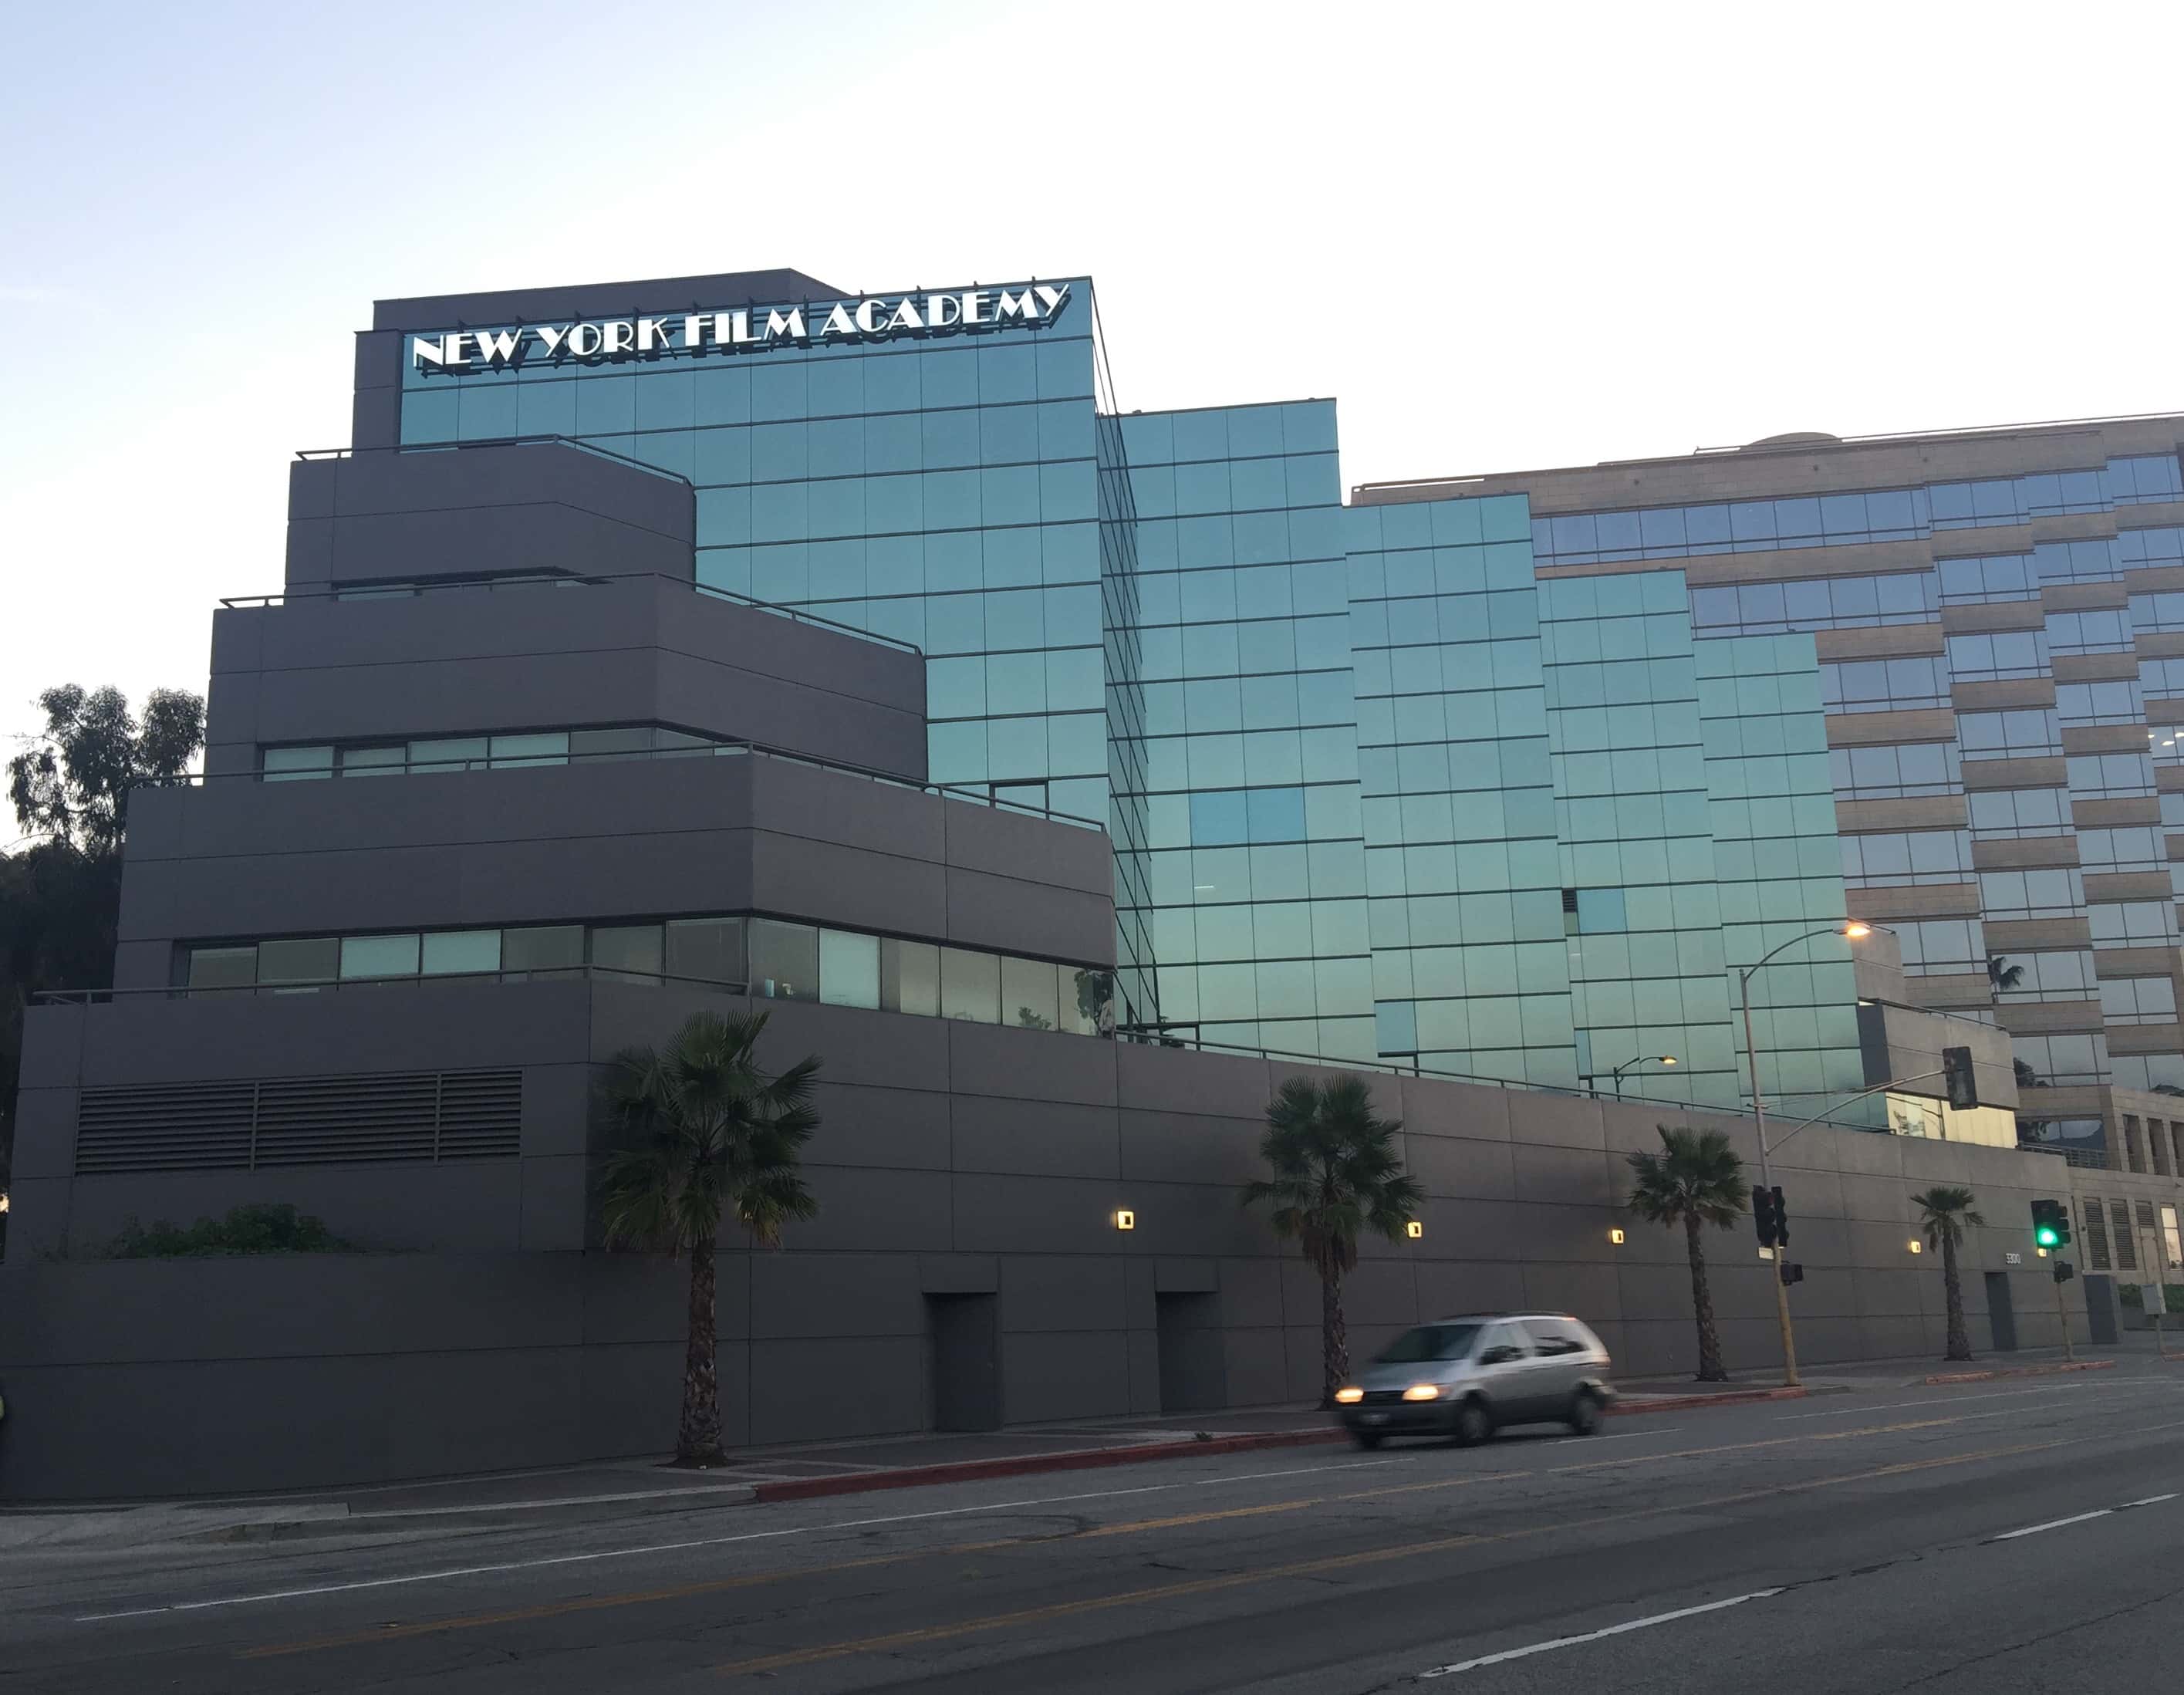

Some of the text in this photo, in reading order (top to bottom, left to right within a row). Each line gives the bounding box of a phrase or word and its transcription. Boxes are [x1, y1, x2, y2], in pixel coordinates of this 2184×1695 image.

[413, 283, 1070, 367] NEW YORK FILM ACADEMY
